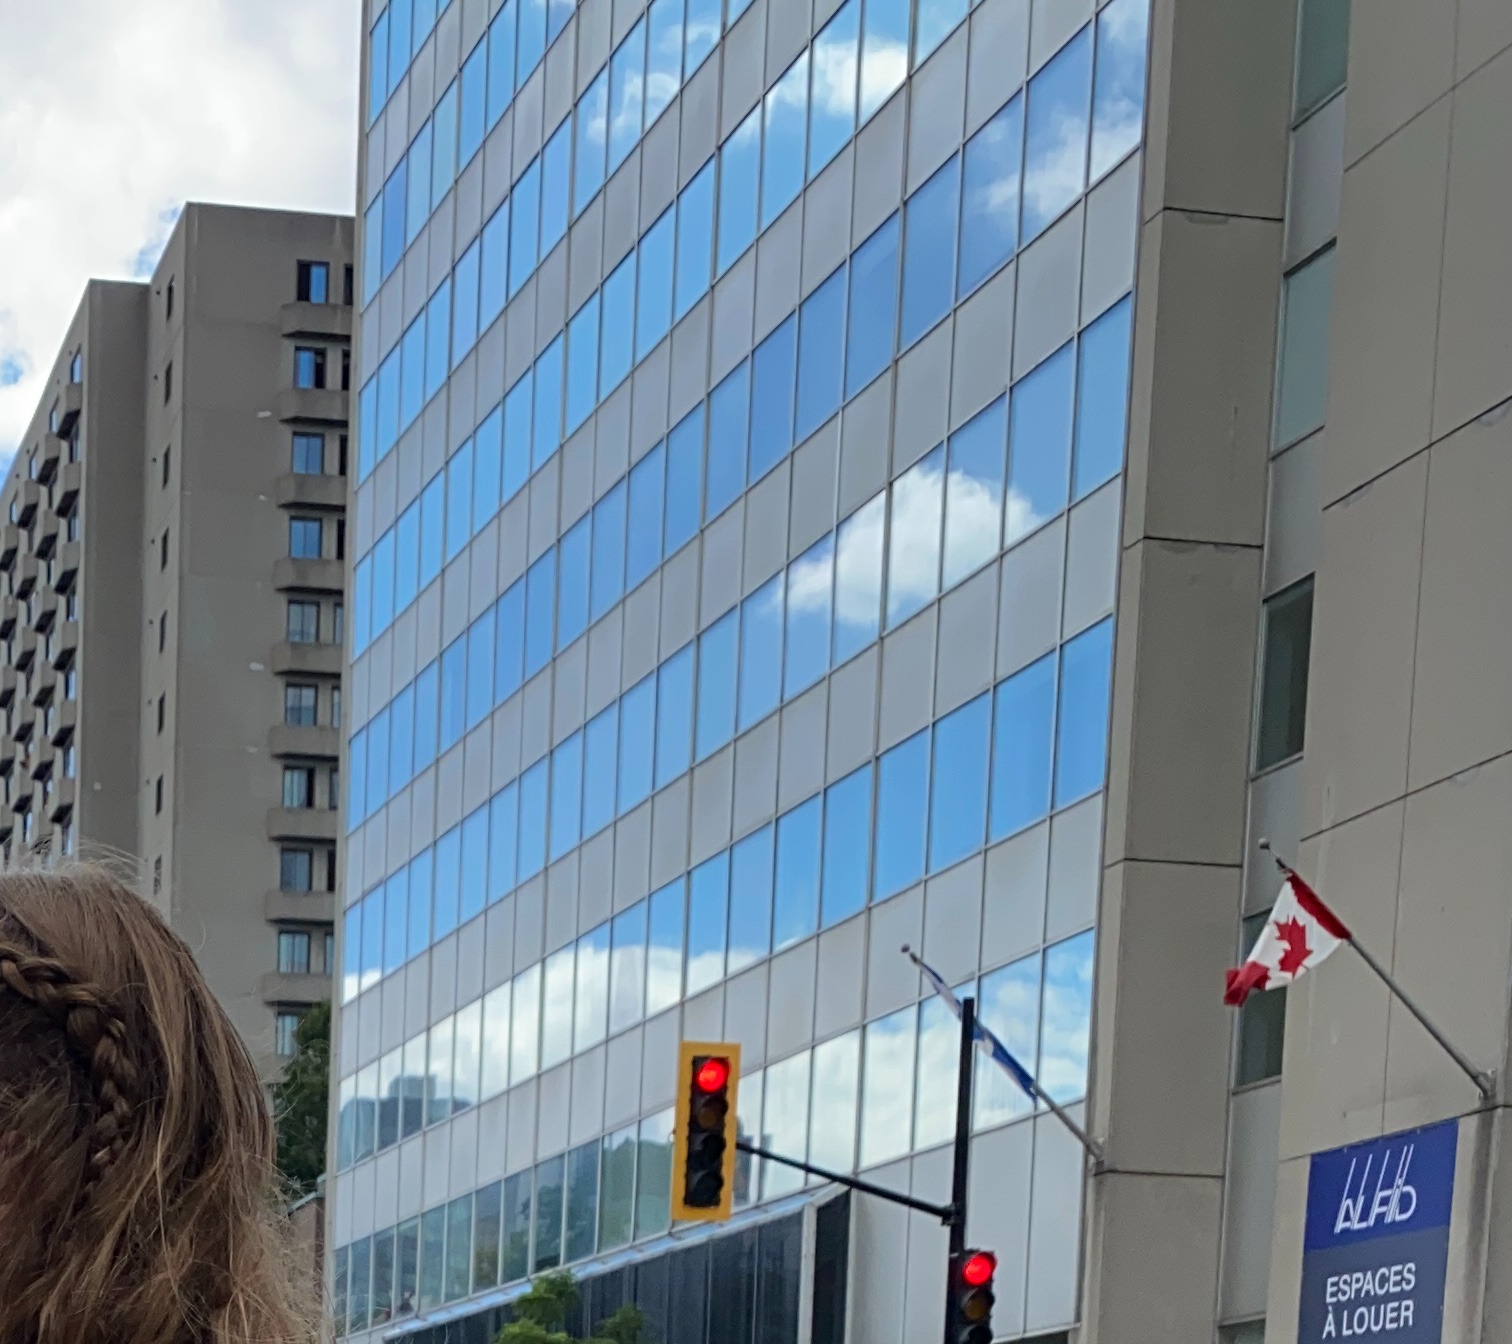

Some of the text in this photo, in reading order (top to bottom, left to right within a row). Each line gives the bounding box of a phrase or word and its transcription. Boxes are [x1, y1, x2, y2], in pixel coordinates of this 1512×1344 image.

[1325, 1262, 1416, 1304] ESPACES
[1321, 1299, 1414, 1340] À LOUER
